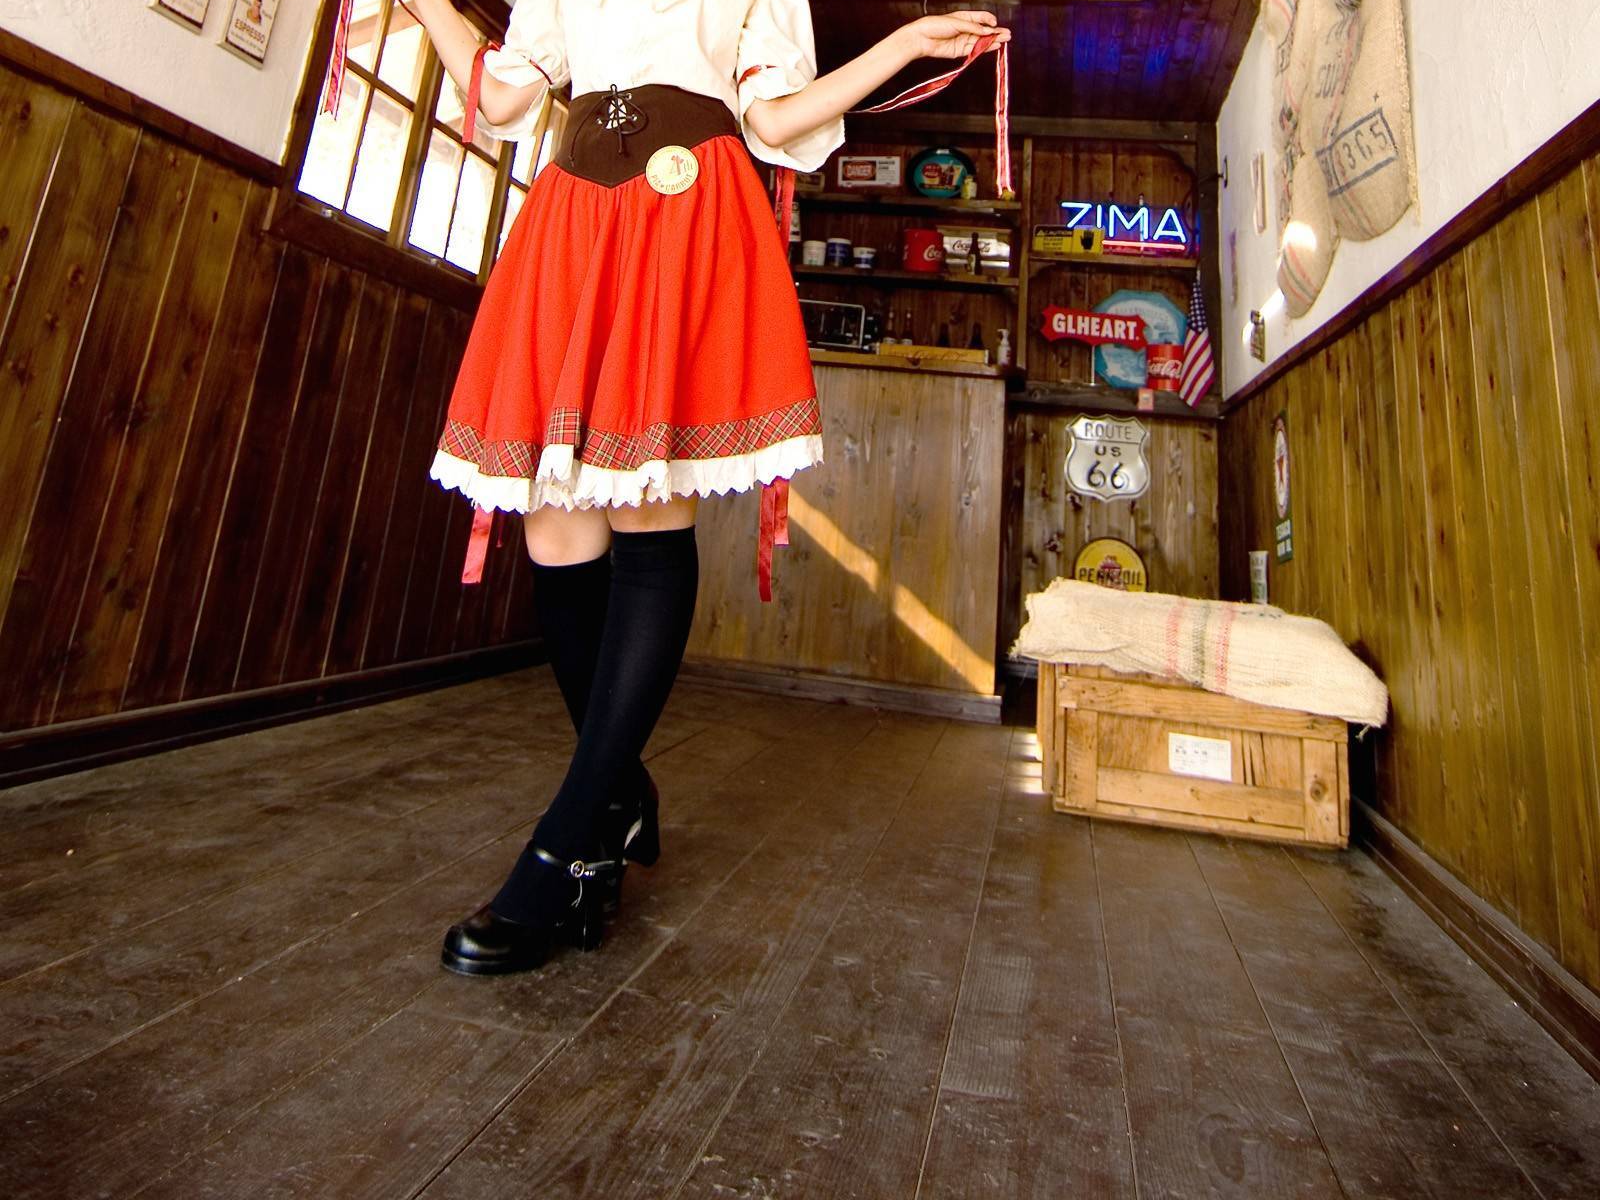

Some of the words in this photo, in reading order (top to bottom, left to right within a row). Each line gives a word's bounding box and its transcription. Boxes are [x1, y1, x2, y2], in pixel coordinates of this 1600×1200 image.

[1061, 202, 1187, 243] ZIMA
[1084, 422, 1132, 440] ROUTE
[1094, 445, 1122, 457] US
[1087, 460, 1131, 490] 66
